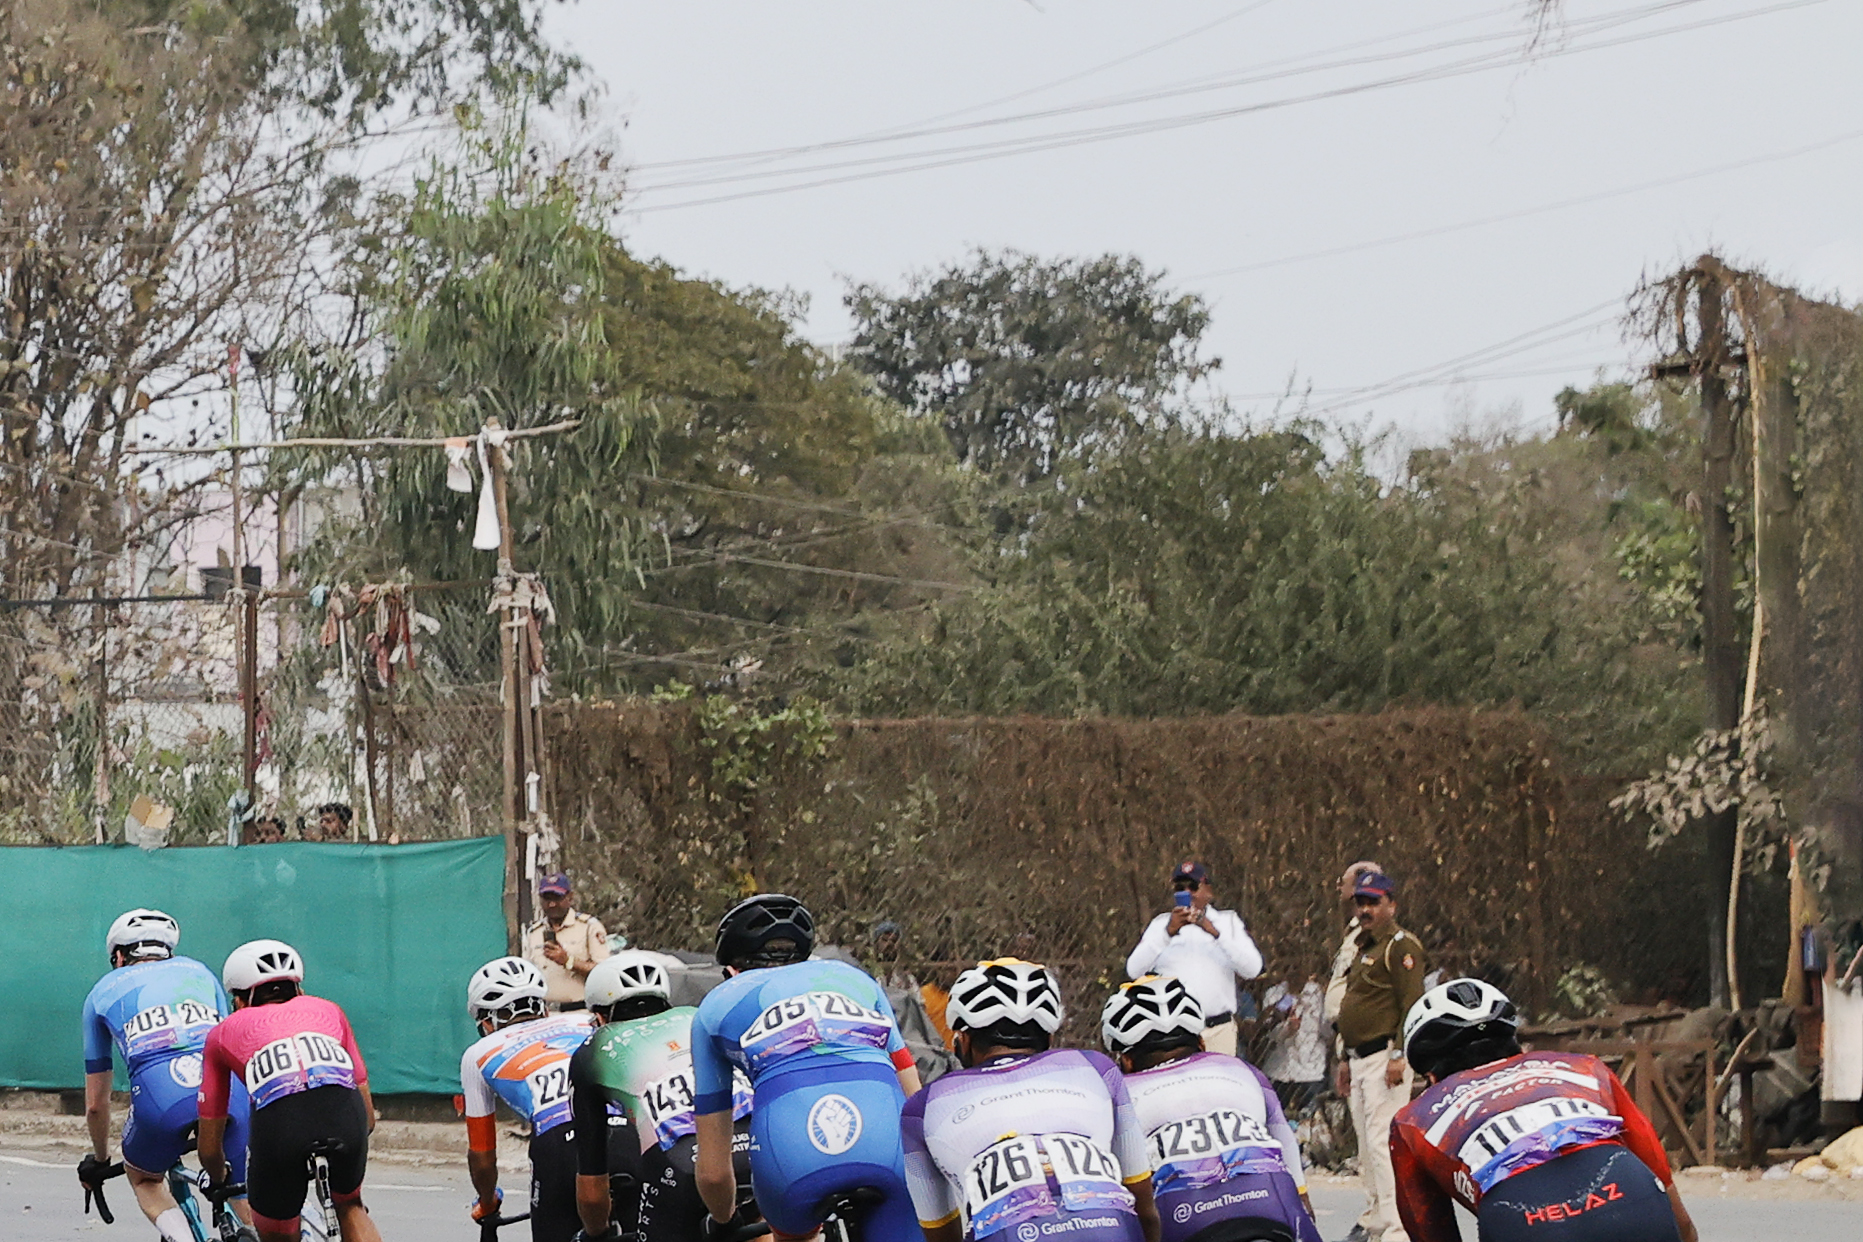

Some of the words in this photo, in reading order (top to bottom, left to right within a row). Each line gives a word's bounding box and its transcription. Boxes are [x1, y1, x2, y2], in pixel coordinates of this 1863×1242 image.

[125, 1006, 170, 1041] 203
[251, 1042, 293, 1085] 106
[298, 1035, 347, 1064] 106
[535, 1067, 568, 1105] 22
[643, 1074, 695, 1122] 143
[1491, 1077, 1563, 1099] FACTOR
[1152, 1117, 1212, 1160] 123
[1209, 1110, 1268, 1146] 123
[1473, 1114, 1526, 1157] 111
[974, 1142, 1033, 1202] 126
[1524, 1183, 1625, 1226] HELAZ
